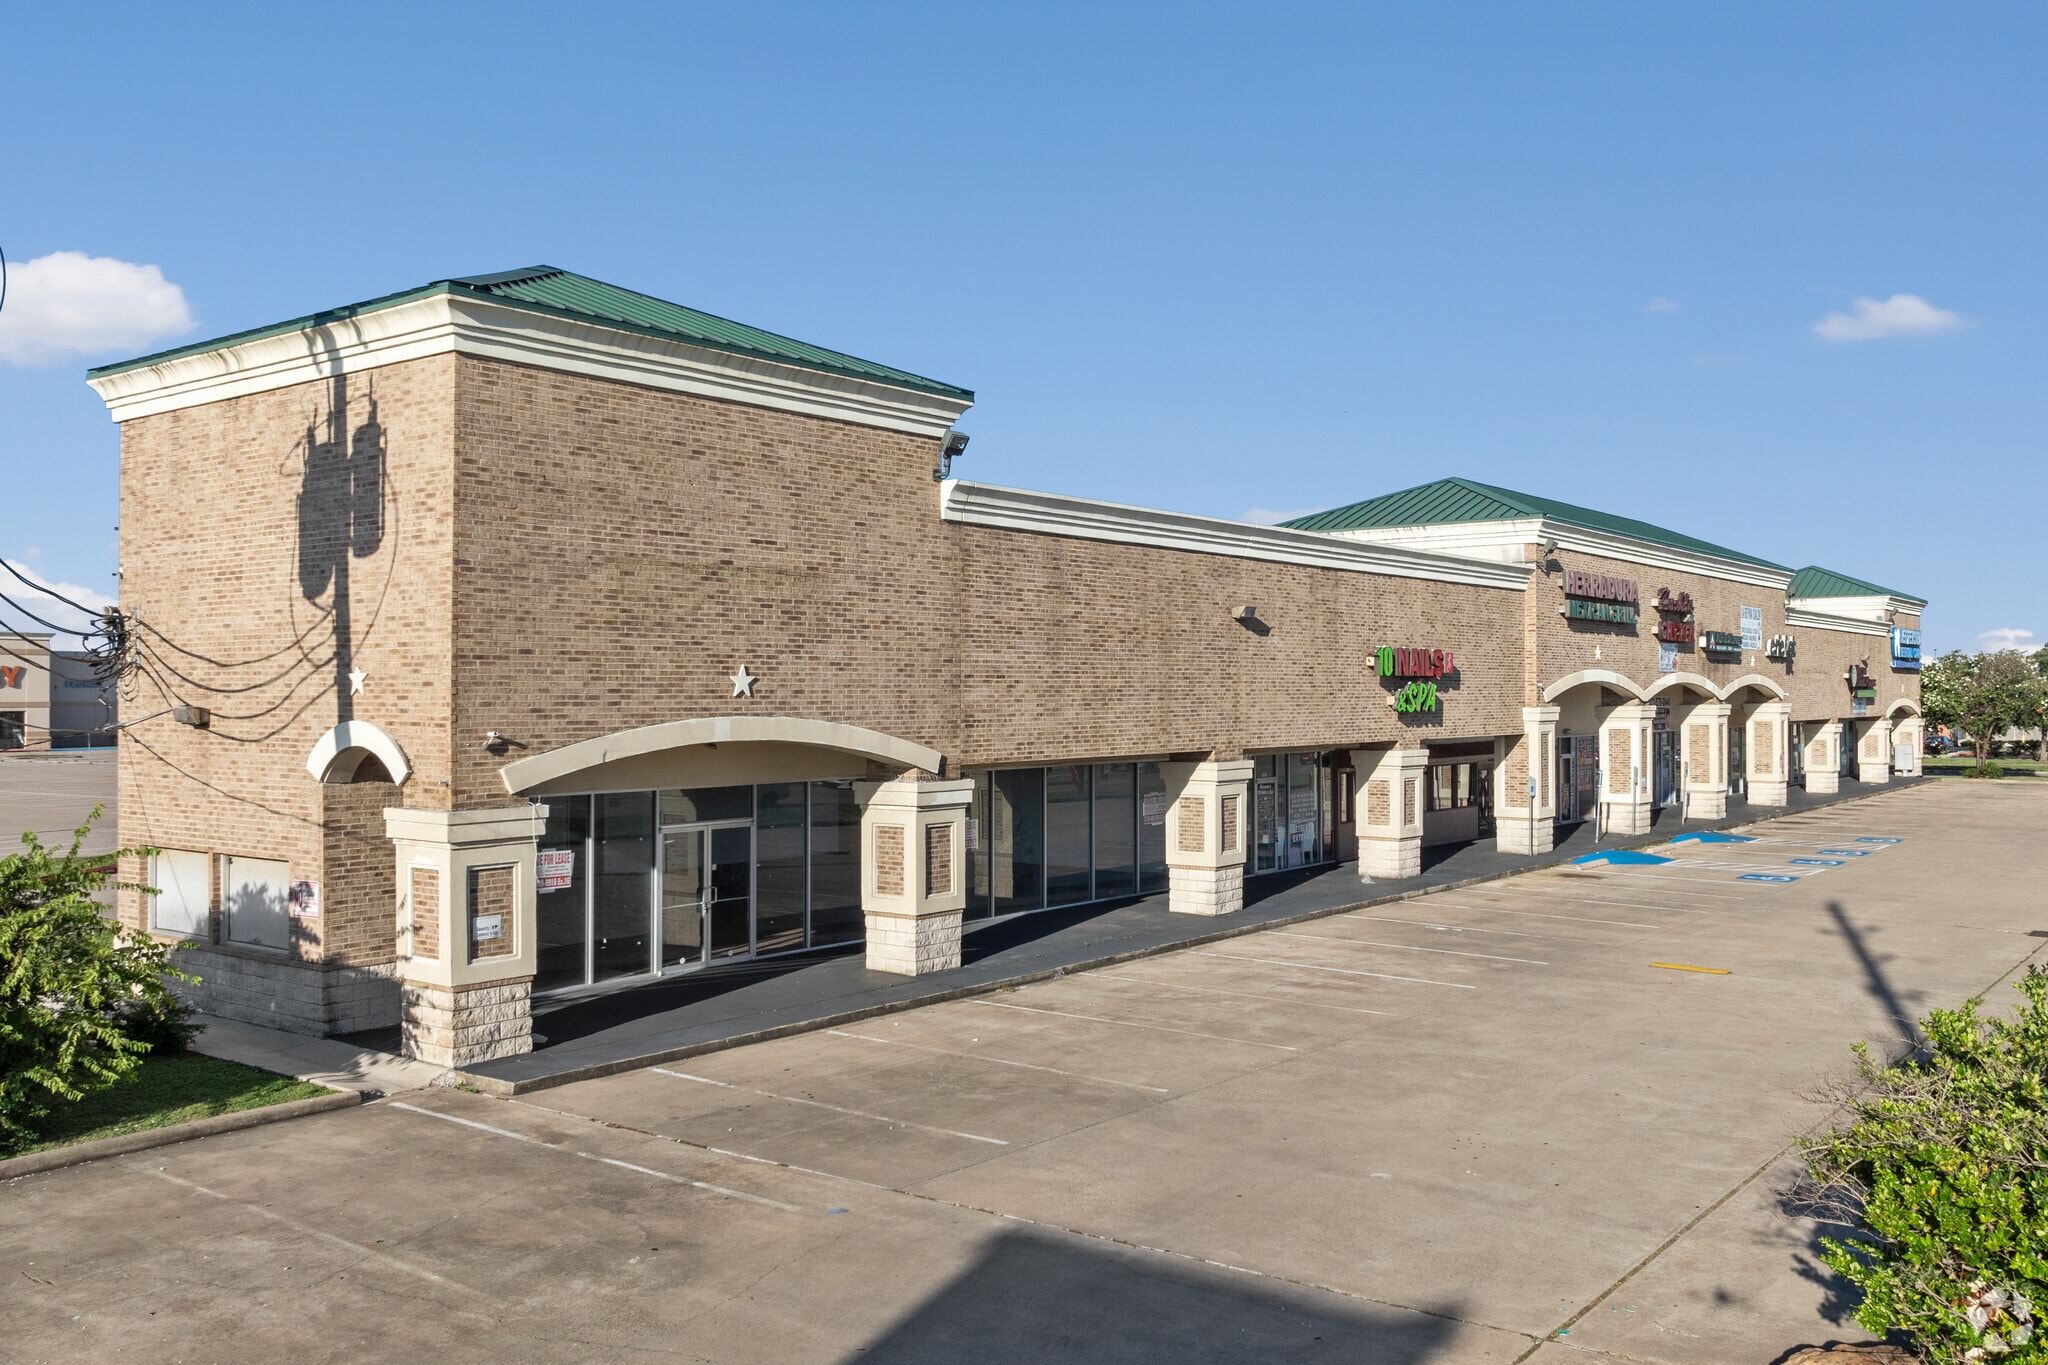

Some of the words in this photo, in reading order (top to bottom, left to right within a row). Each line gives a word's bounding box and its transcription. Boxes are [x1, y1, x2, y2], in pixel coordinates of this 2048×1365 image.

[1566, 570, 1639, 602] HERRADURA
[1570, 600, 1610, 620] MEXICAN
[1611, 605, 1637, 624] GRILL
[1377, 646, 1393, 677] 10
[1397, 647, 1444, 678] NAILS
[544, 853, 554, 865] FOR
[555, 852, 570, 864] LEASE
